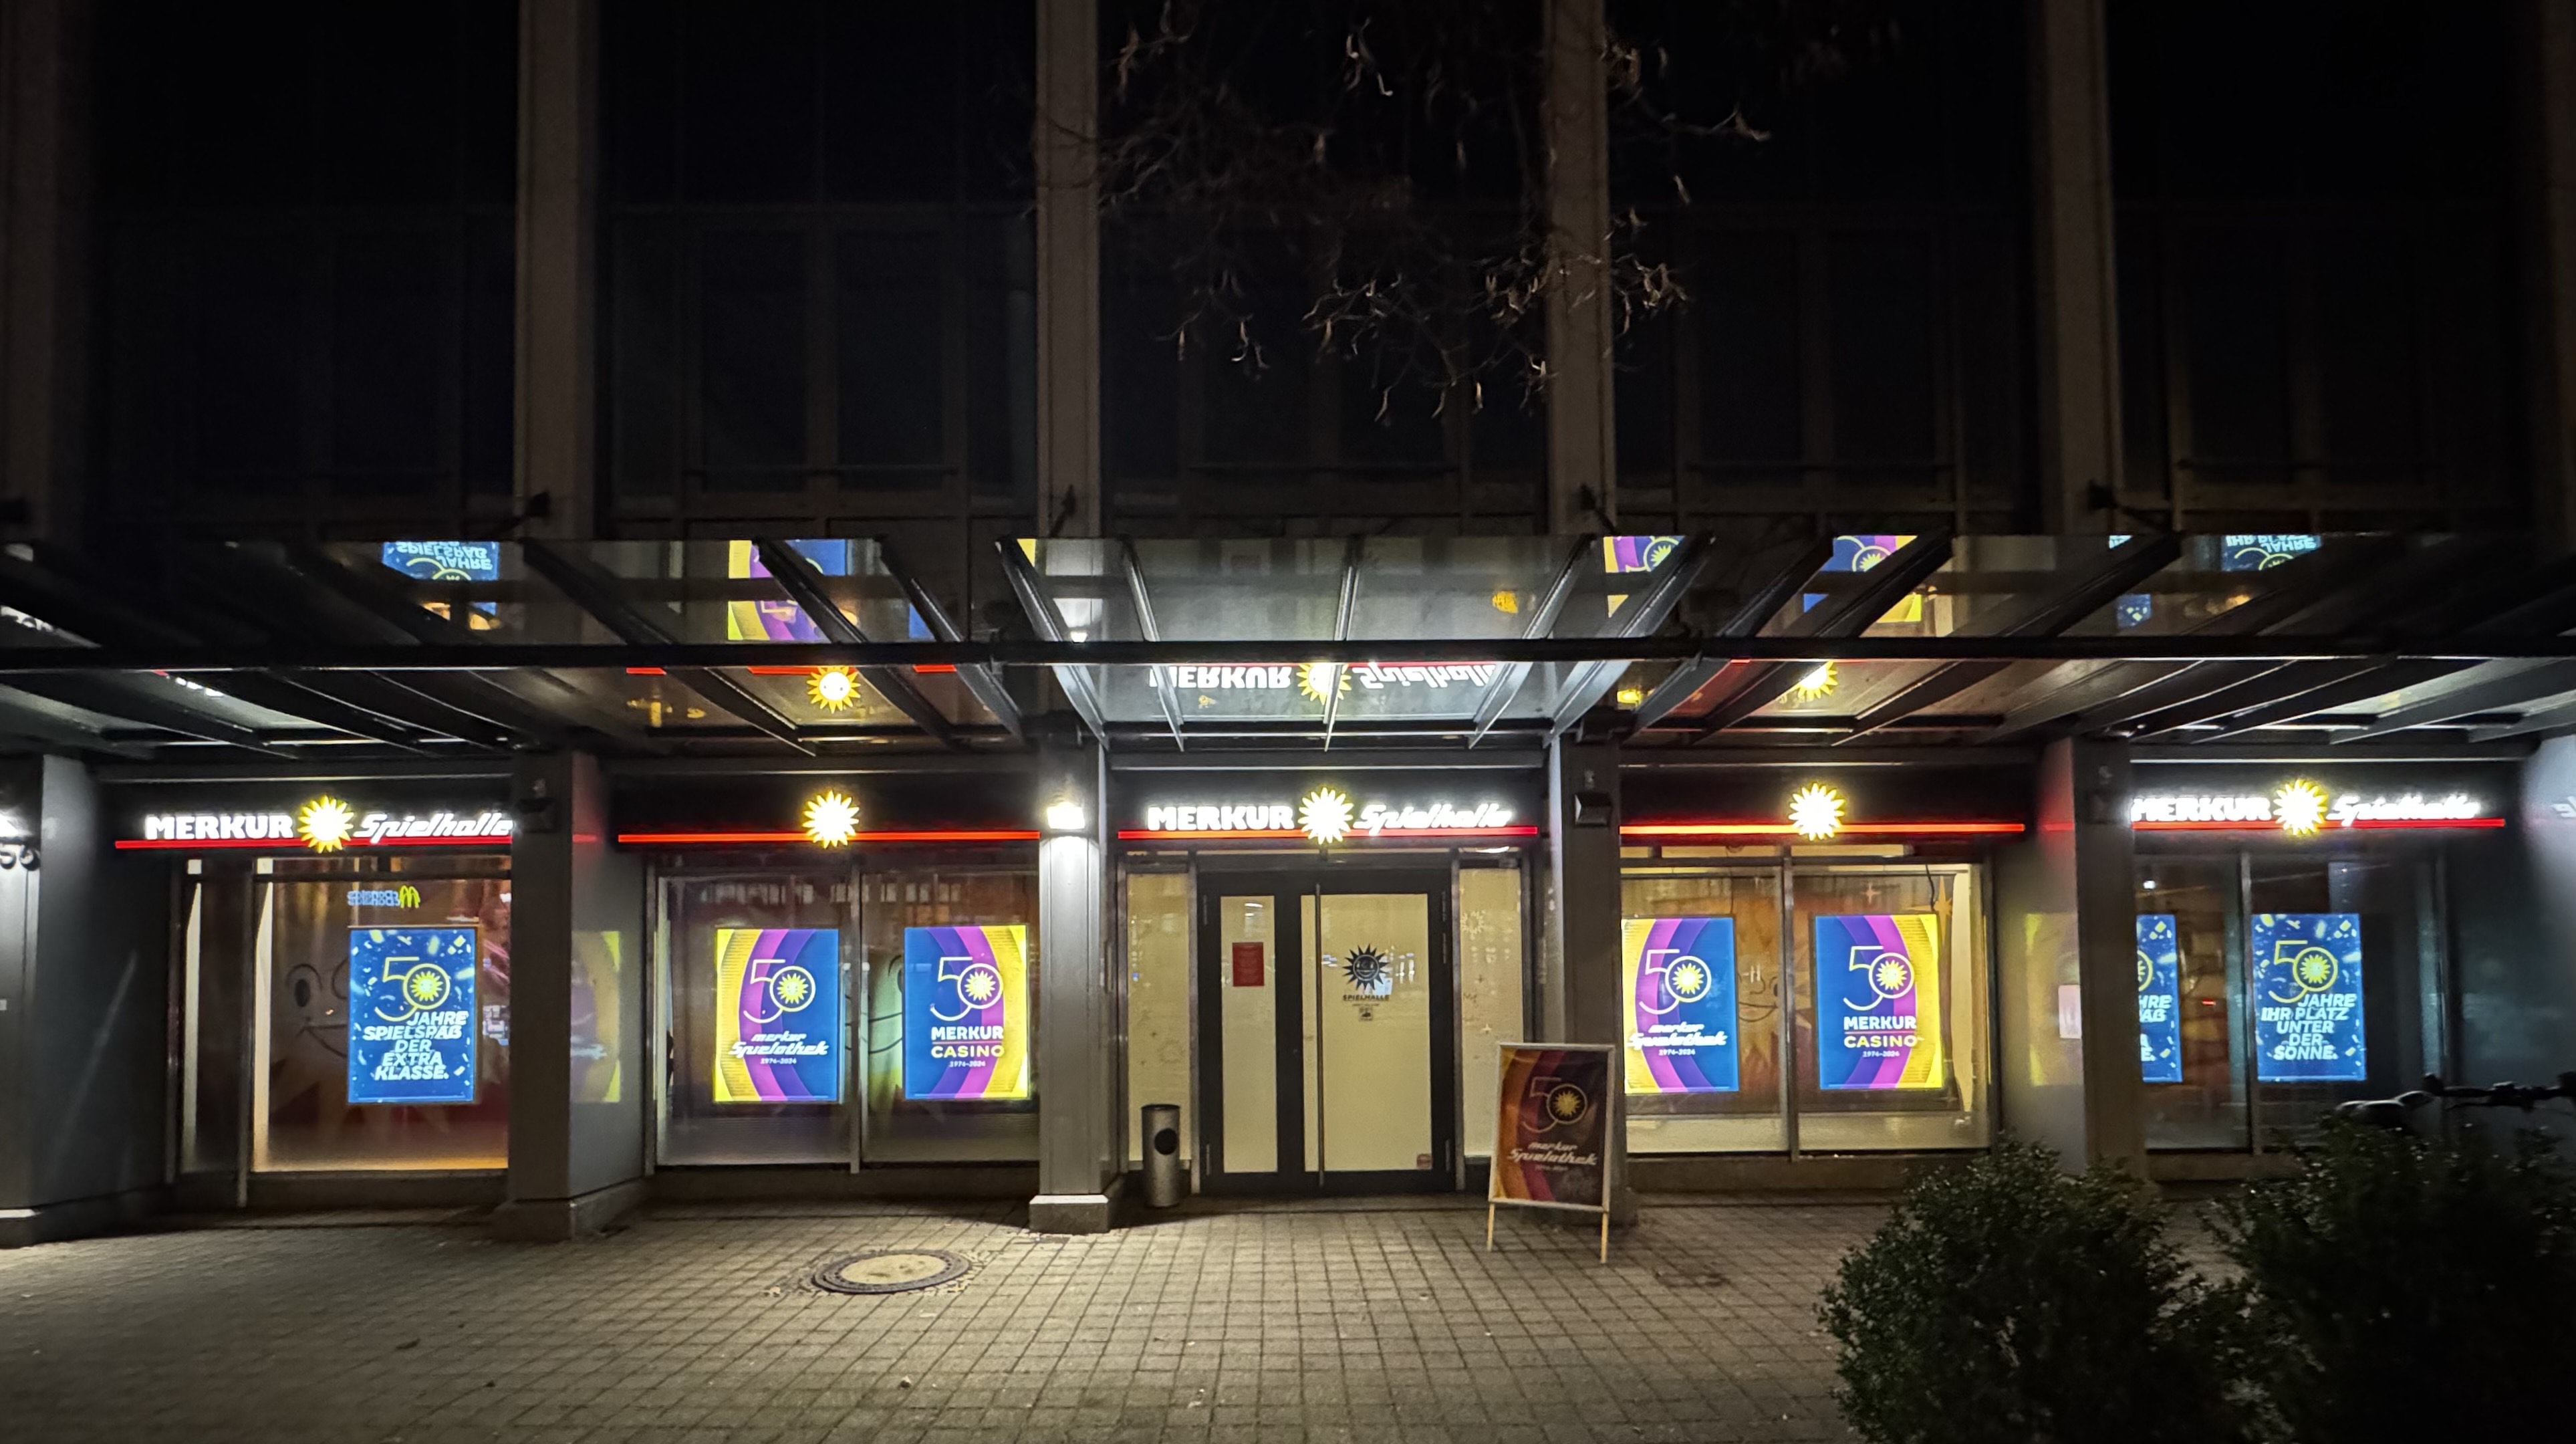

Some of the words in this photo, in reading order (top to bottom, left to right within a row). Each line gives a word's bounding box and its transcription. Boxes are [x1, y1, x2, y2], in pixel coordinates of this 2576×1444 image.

[2131, 797, 2272, 822] MERKUR
[2325, 793, 2481, 827] Spielhalle
[1147, 806, 1295, 831] MERKUR
[1352, 803, 1513, 836] Spielhalle
[144, 814, 293, 840] MERKUR
[354, 812, 513, 844] Spielhalle
[2139, 994, 2172, 1009] HRE
[2297, 993, 2357, 1007] JAHRE
[406, 1010, 469, 1026] JAHRE
[2261, 1007, 2292, 1021] IHR
[2295, 1007, 2350, 1021] PLATZ
[1843, 1015, 1917, 1030] MERKUR
[2276, 1020, 2335, 1034] UNTER
[931, 1026, 1004, 1040] MERKUR
[2289, 1033, 2323, 1046] DER
[394, 1040, 432, 1053] DER
[1843, 1035, 1918, 1048] CASINO
[931, 1045, 1005, 1058] CASINO
[2273, 1044, 2339, 1060] SONNE.
[382, 1052, 443, 1066] EXTRA
[374, 1066, 450, 1081] KLASSE.
